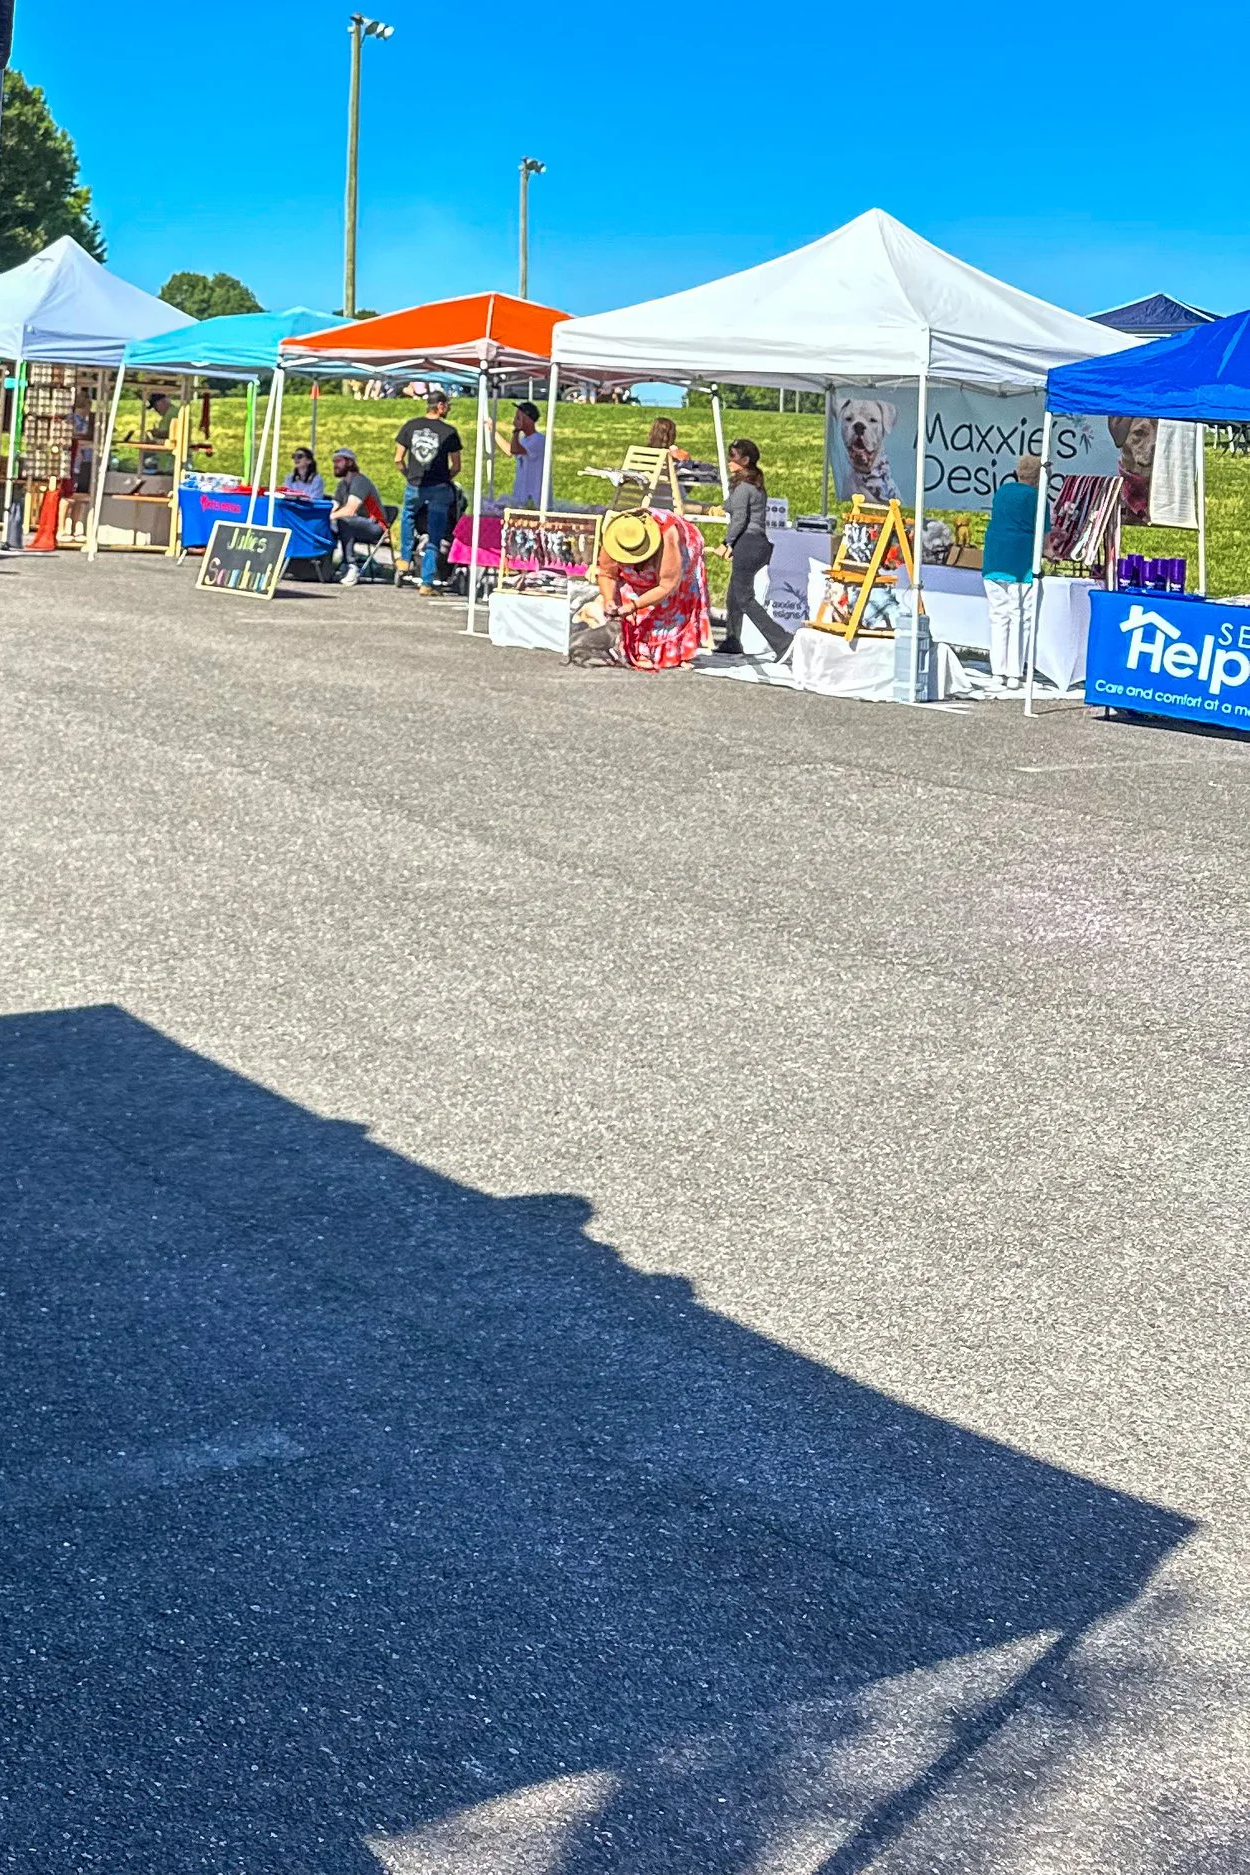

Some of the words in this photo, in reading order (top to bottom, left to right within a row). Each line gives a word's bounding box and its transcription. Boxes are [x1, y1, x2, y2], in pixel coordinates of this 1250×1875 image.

[913, 412, 1078, 459] Maxxie's
[924, 454, 1066, 502] Desis
[1126, 625, 1250, 695] Help
[1095, 679, 1124, 695] Care
[1126, 686, 1153, 700] and
[1155, 691, 1202, 708] comfort
[1204, 699, 1219, 711] at
[1221, 703, 1232, 714] a
